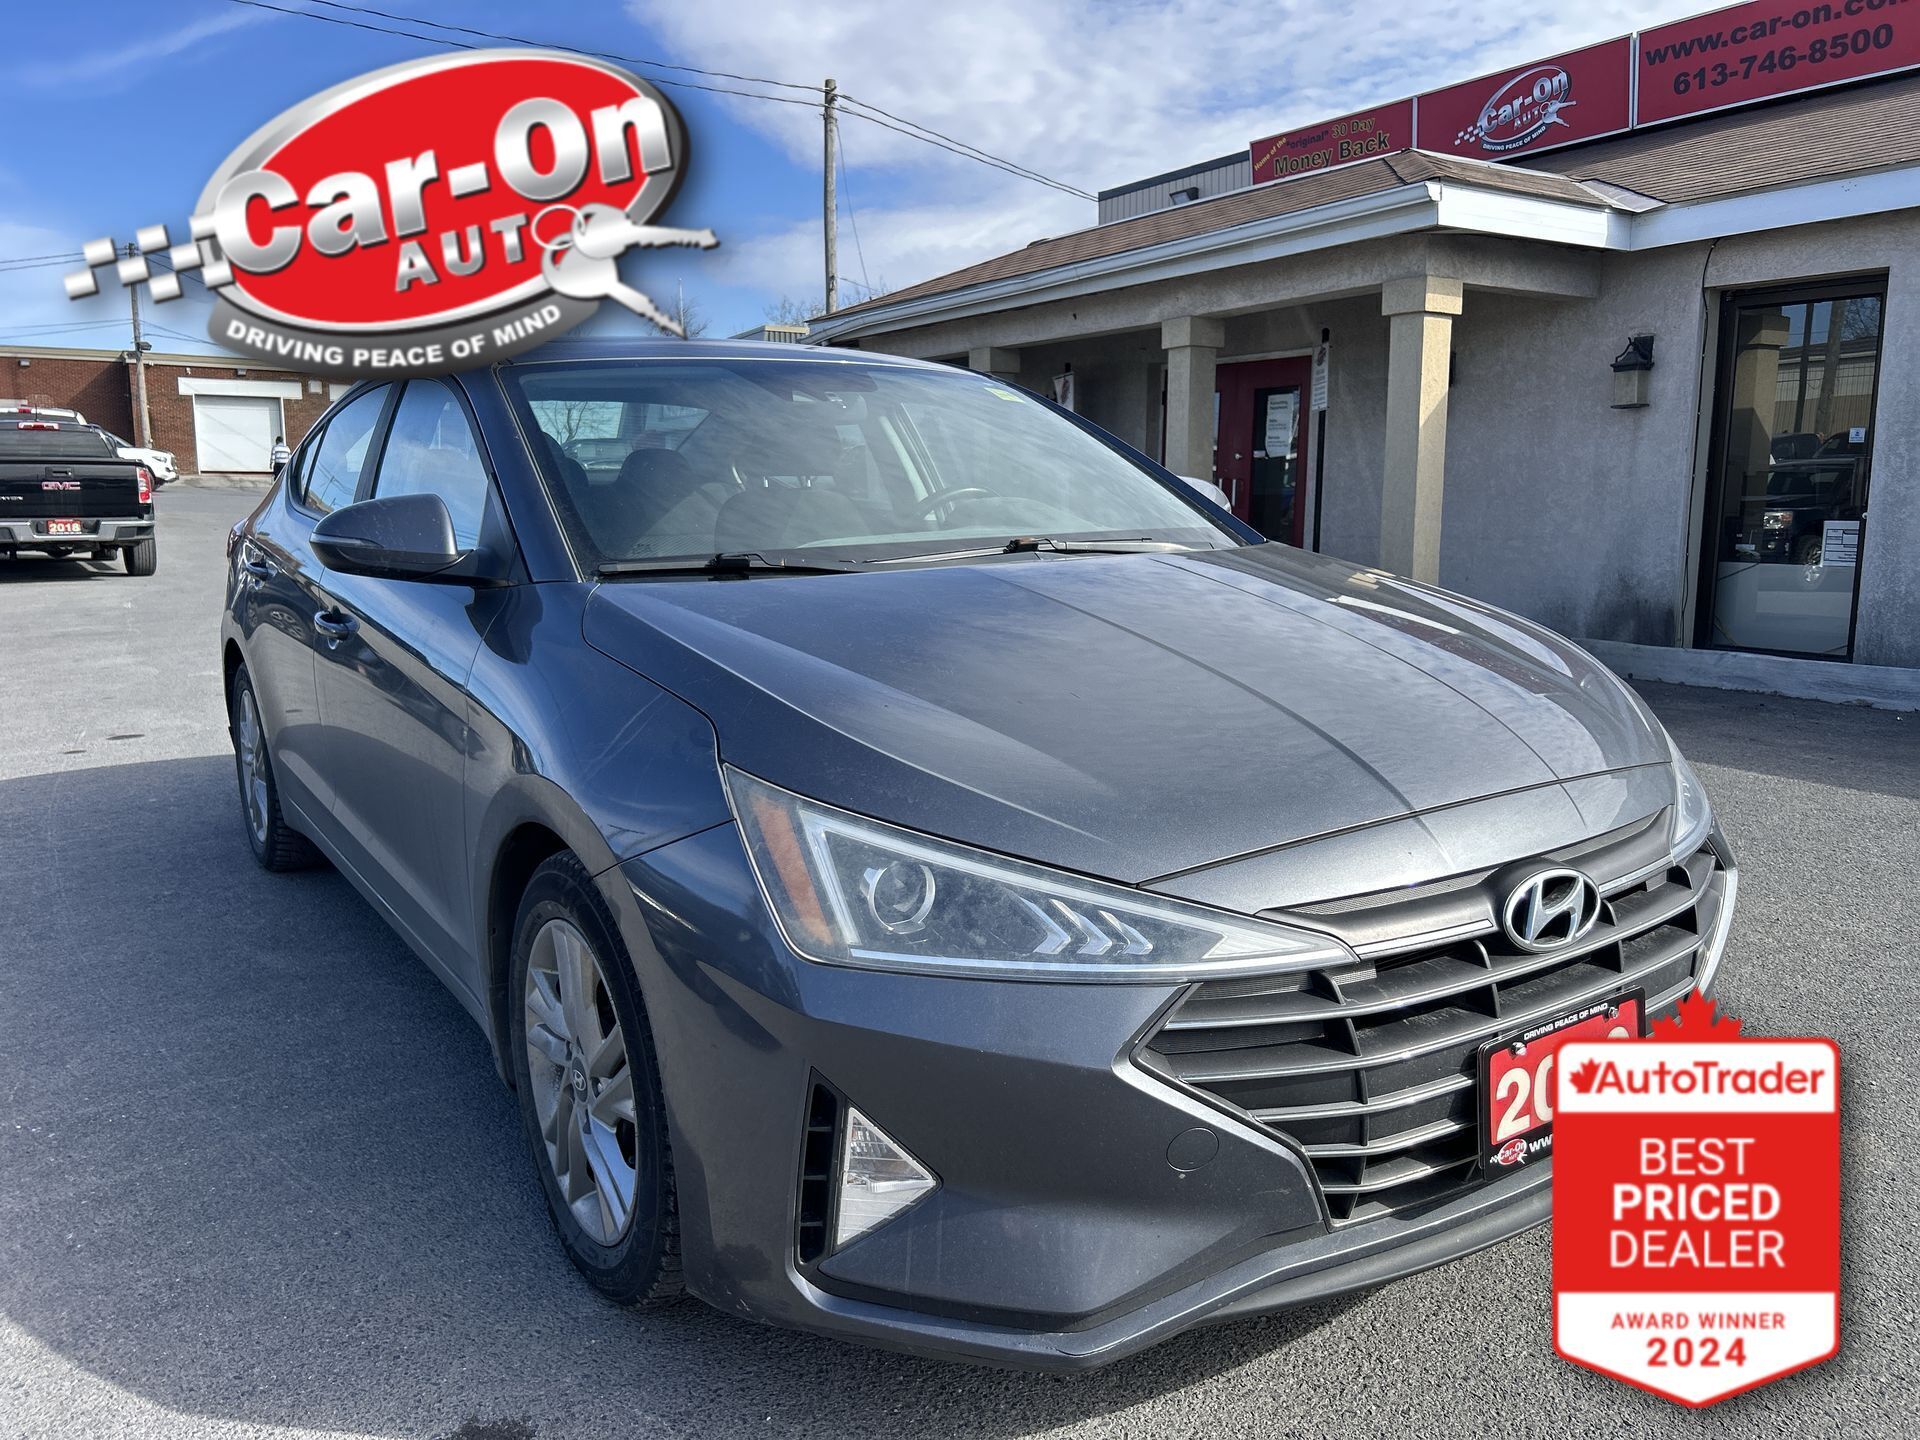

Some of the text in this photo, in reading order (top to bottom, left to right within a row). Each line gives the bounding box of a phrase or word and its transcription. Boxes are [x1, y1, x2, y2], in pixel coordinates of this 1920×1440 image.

[1645, 0, 1909, 66] www.car-on.co
[1673, 23, 1893, 95] 613-746-8500
[1481, 72, 1568, 132] Car-On
[1331, 117, 1376, 139] 30 Day
[1482, 143, 1505, 151] DRIVING
[1505, 140, 1524, 150] PEACE
[1532, 125, 1546, 139] MIND
[1254, 136, 1287, 171] Home of the
[1273, 130, 1390, 177] Money Back
[42, 481, 81, 490] GMC
[49, 522, 81, 532] 2018
[1523, 1003, 1608, 1040] DRIVING PEACE OF MIND
